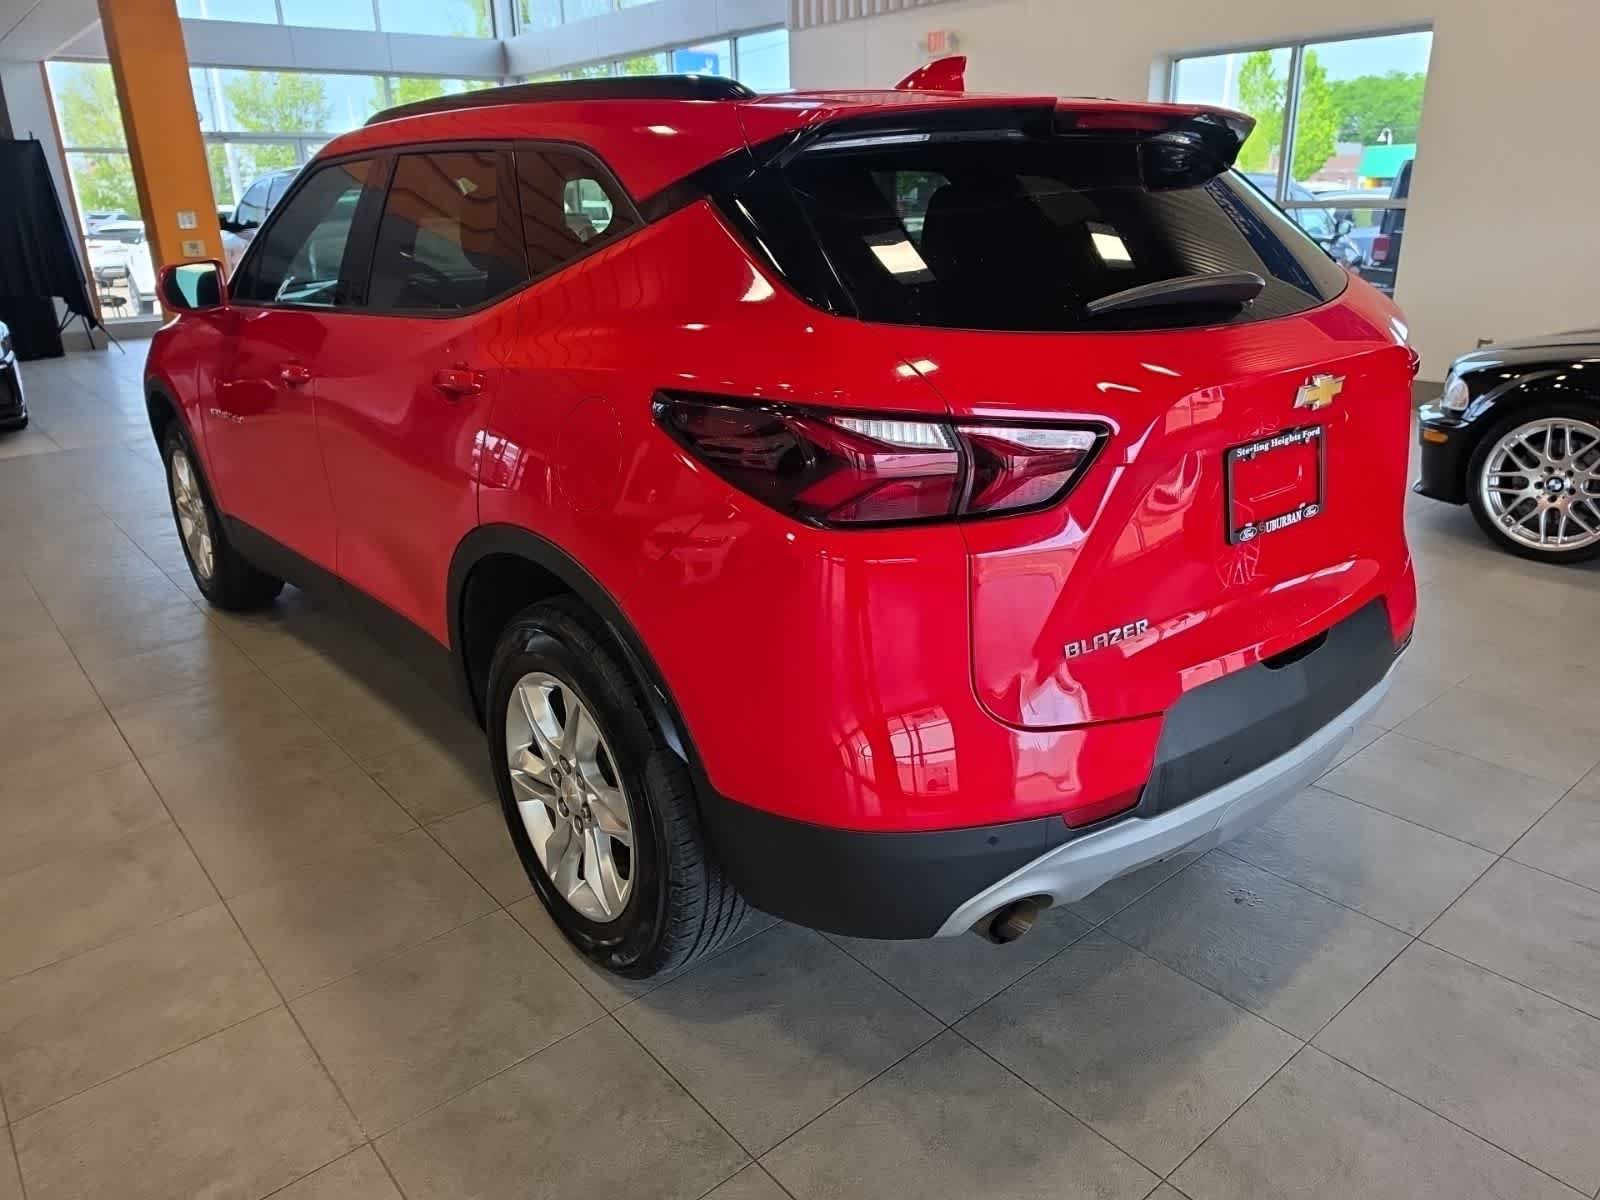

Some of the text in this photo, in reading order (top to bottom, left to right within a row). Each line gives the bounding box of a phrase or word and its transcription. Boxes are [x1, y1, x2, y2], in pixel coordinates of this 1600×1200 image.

[1236, 426, 1321, 457] Sterling Heights Ford
[1259, 510, 1302, 534] SUBURBAN
[1064, 618, 1149, 660] BLAZER
